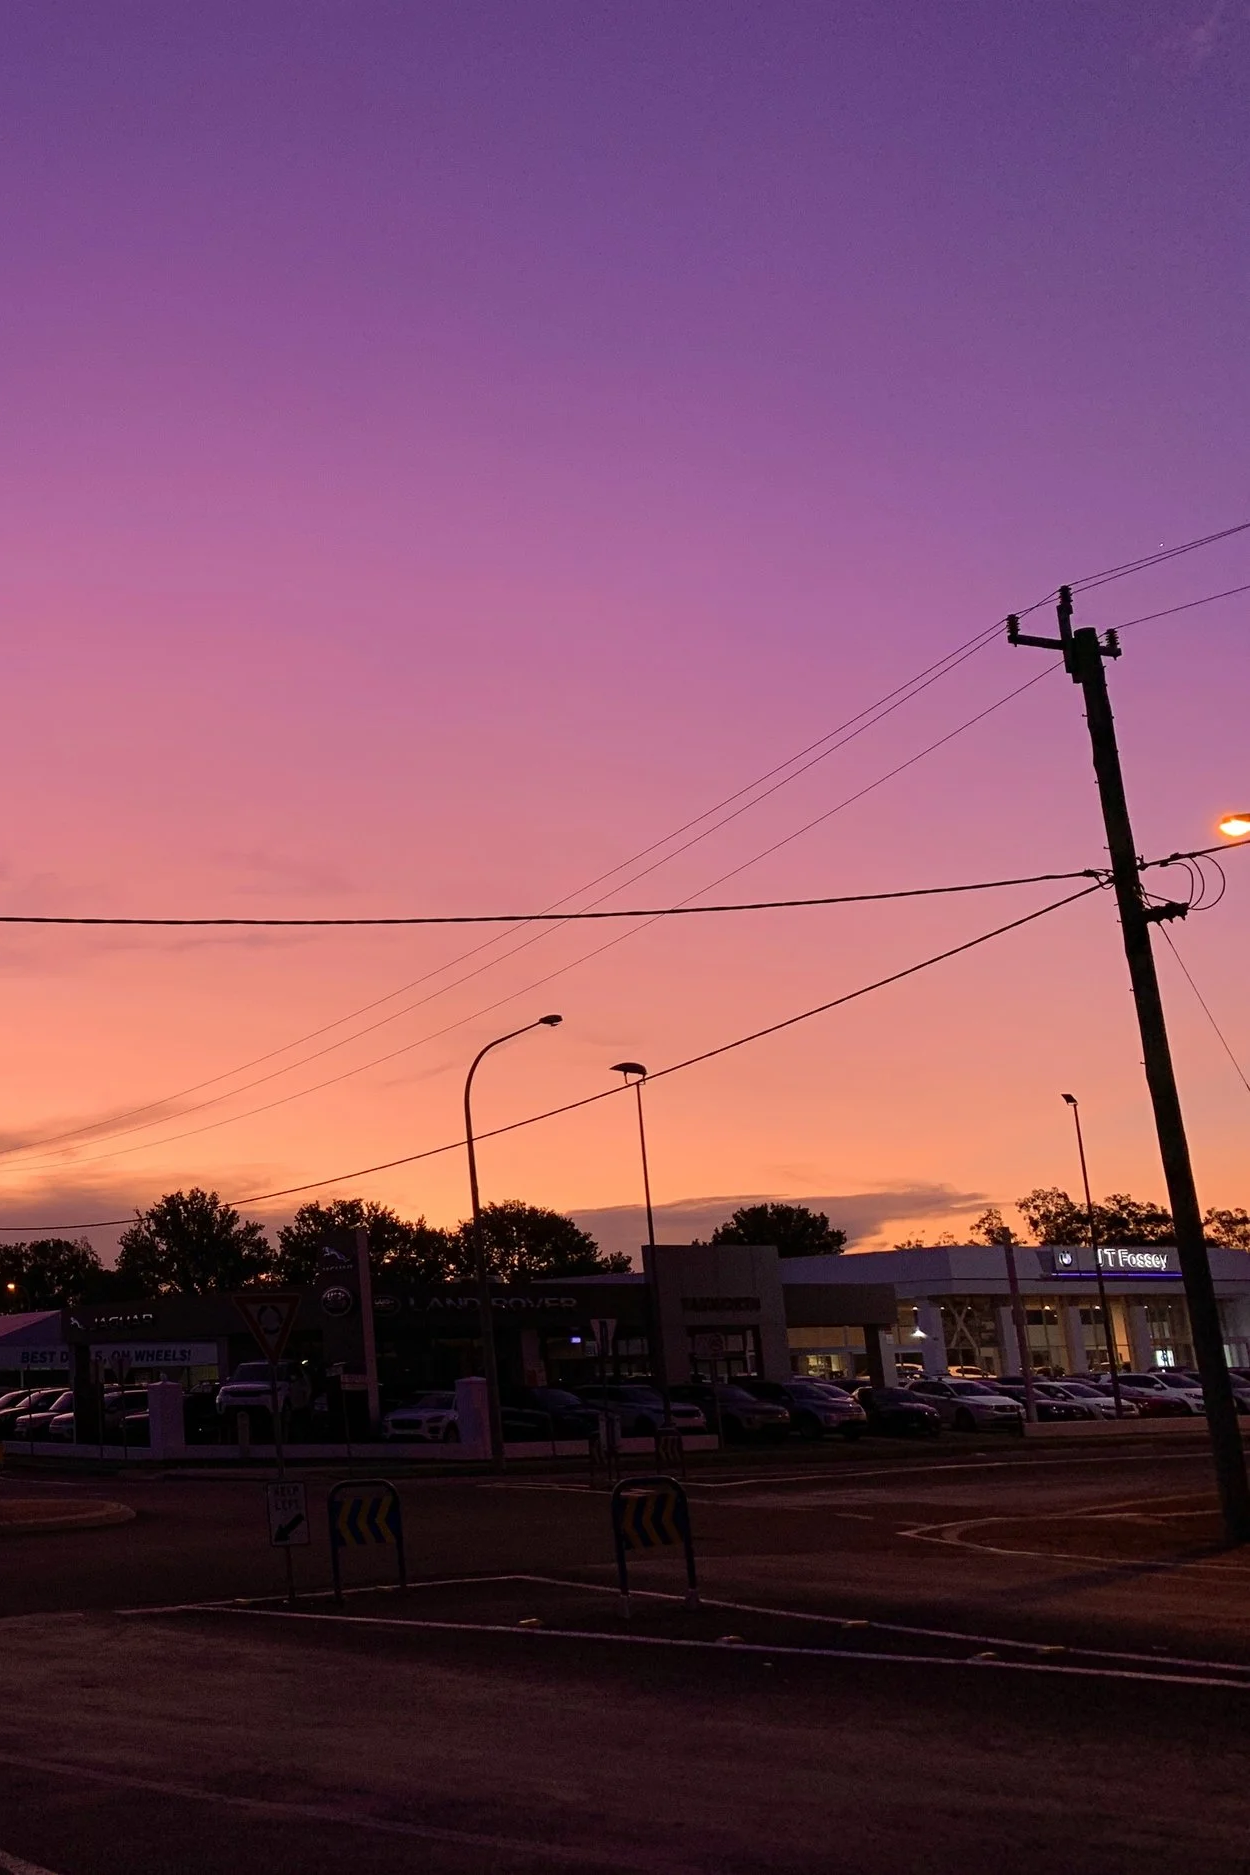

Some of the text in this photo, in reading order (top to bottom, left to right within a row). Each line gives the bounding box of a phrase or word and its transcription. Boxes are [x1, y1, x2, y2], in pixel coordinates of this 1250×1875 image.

[1117, 1248, 1169, 1272] Fossey
[407, 1296, 482, 1313] LAND
[491, 1296, 580, 1312] ROVER
[91, 1312, 155, 1331] JAGUAR
[21, 1351, 55, 1364] BEST
[134, 1348, 192, 1362] WHEELS!
[272, 1485, 300, 1497] KEEP
[273, 1499, 300, 1511] LEFT
